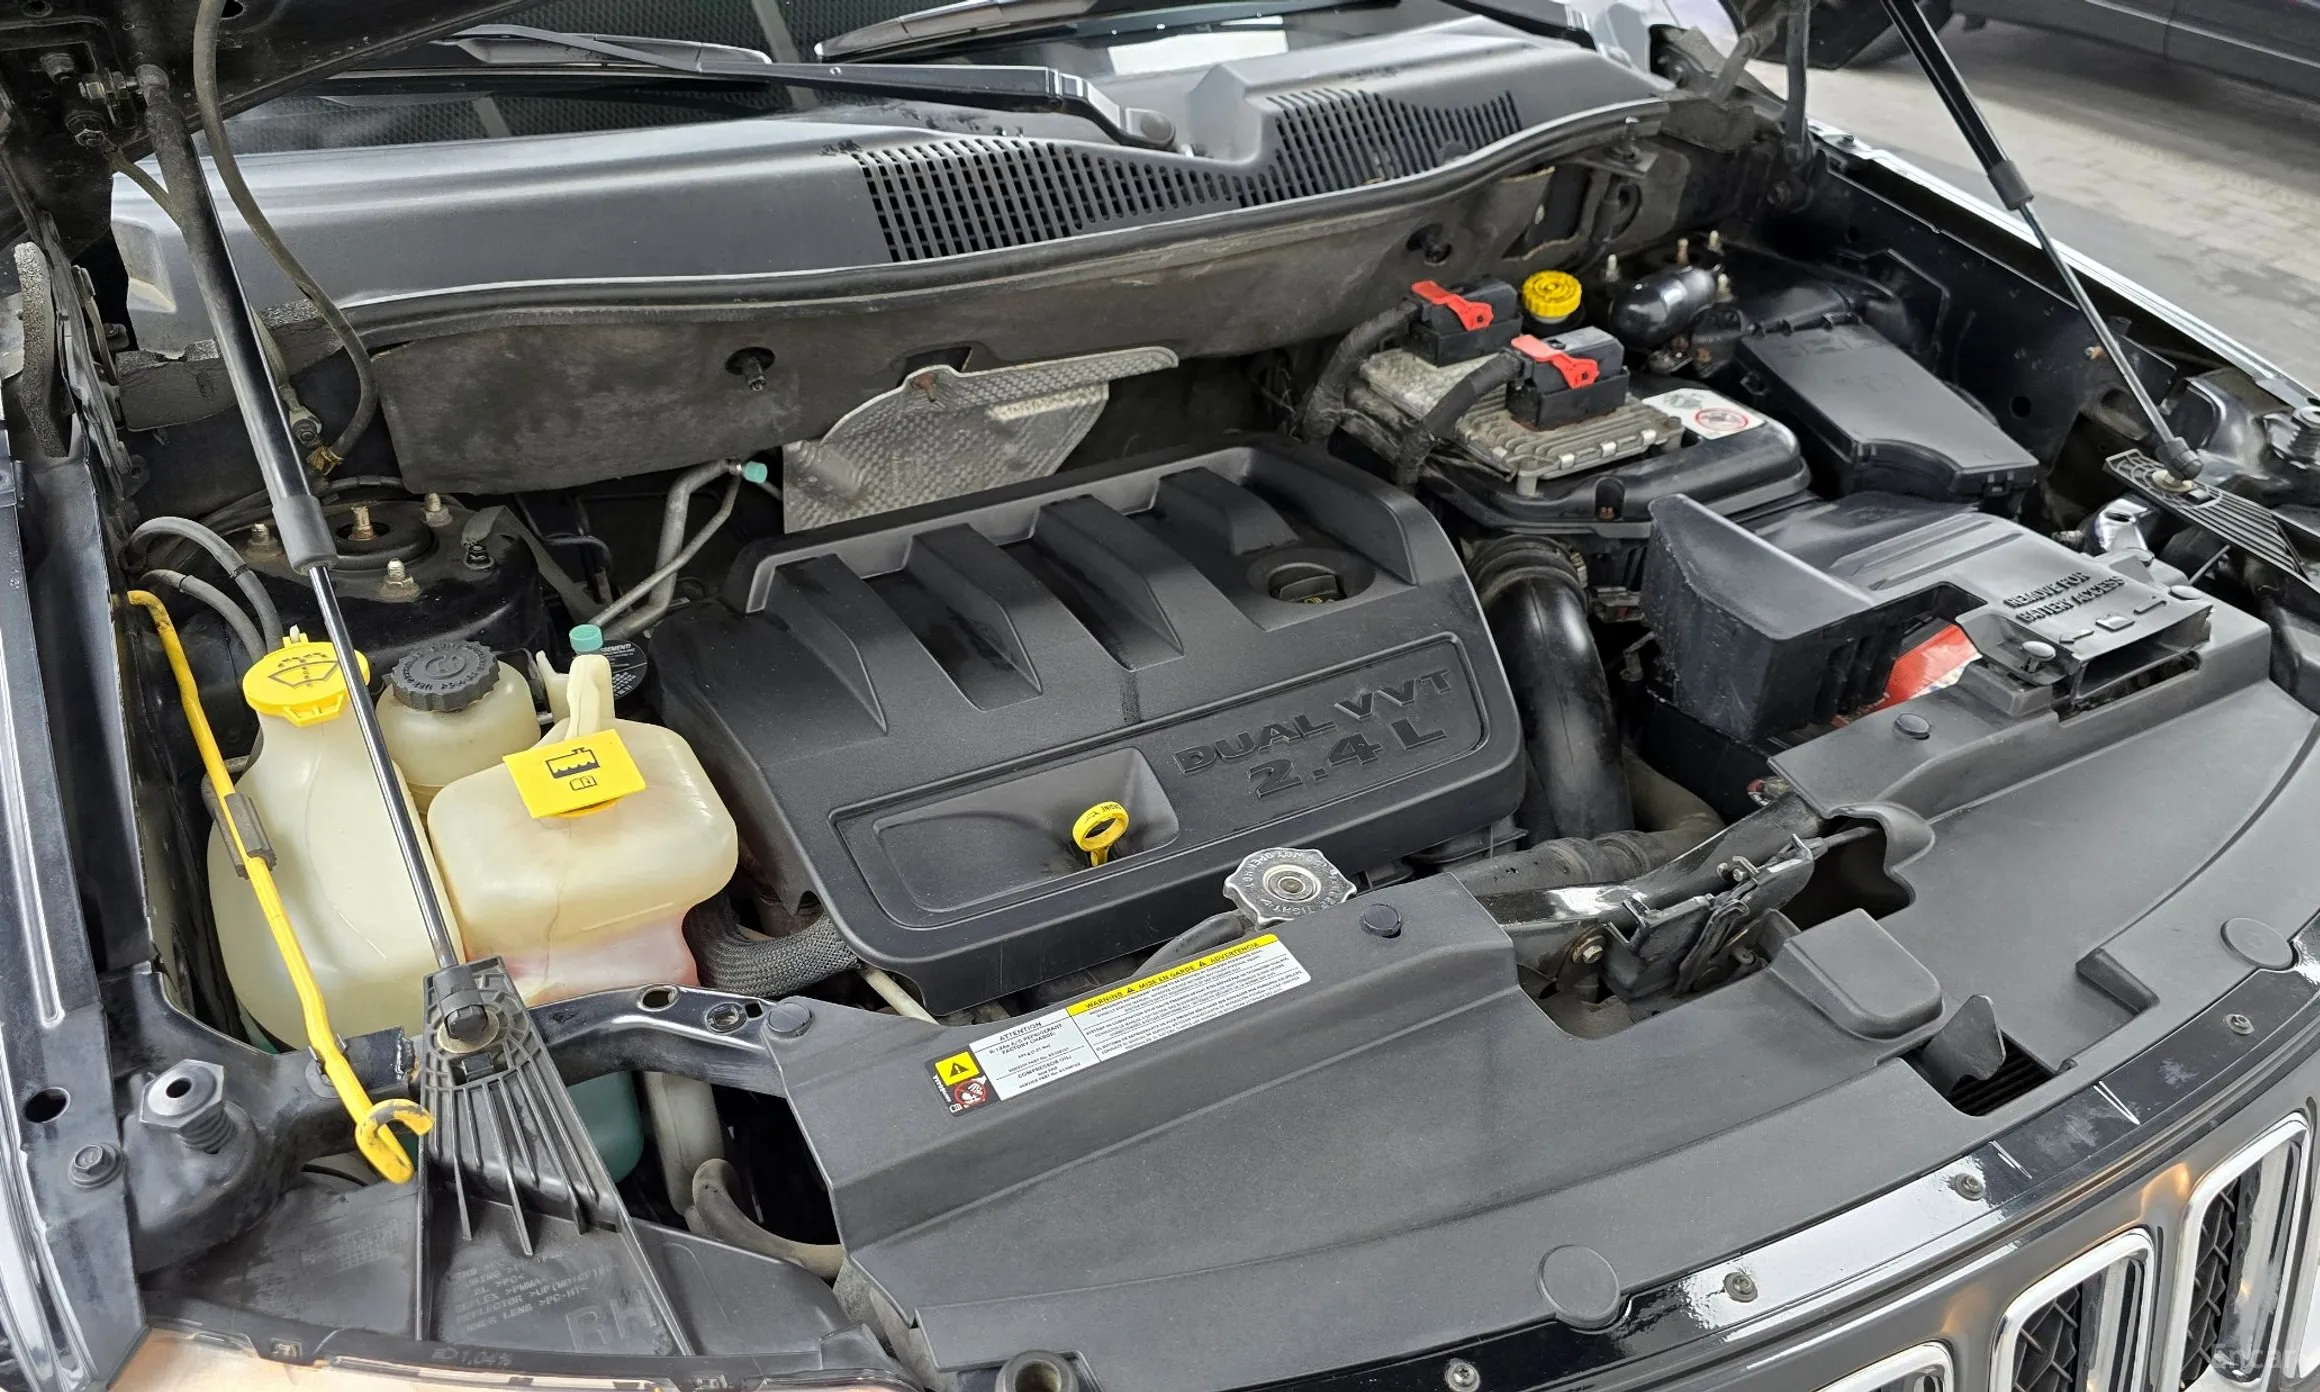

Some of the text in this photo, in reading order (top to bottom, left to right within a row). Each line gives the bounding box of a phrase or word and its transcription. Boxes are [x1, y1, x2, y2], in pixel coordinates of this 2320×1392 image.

[2003, 571, 2091, 609] REMOVE FOR
[2016, 576, 2125, 624] BATTERY ACCESS
[1172, 668, 1453, 775] DUAL VVT
[1210, 942, 1260, 963] ADVERTENCIA
[1138, 965, 1195, 990] MISE EN GARDE
[1085, 991, 1123, 1009] WARNING
[1000, 1022, 1042, 1041] ATTENTION
[1022, 1023, 1063, 1041] REFRIGERANT
[1001, 1041, 1029, 1055] FACTORY
[1018, 1058, 1059, 1079] COMPRESSOR
[564, 1286, 657, 1354] RH
